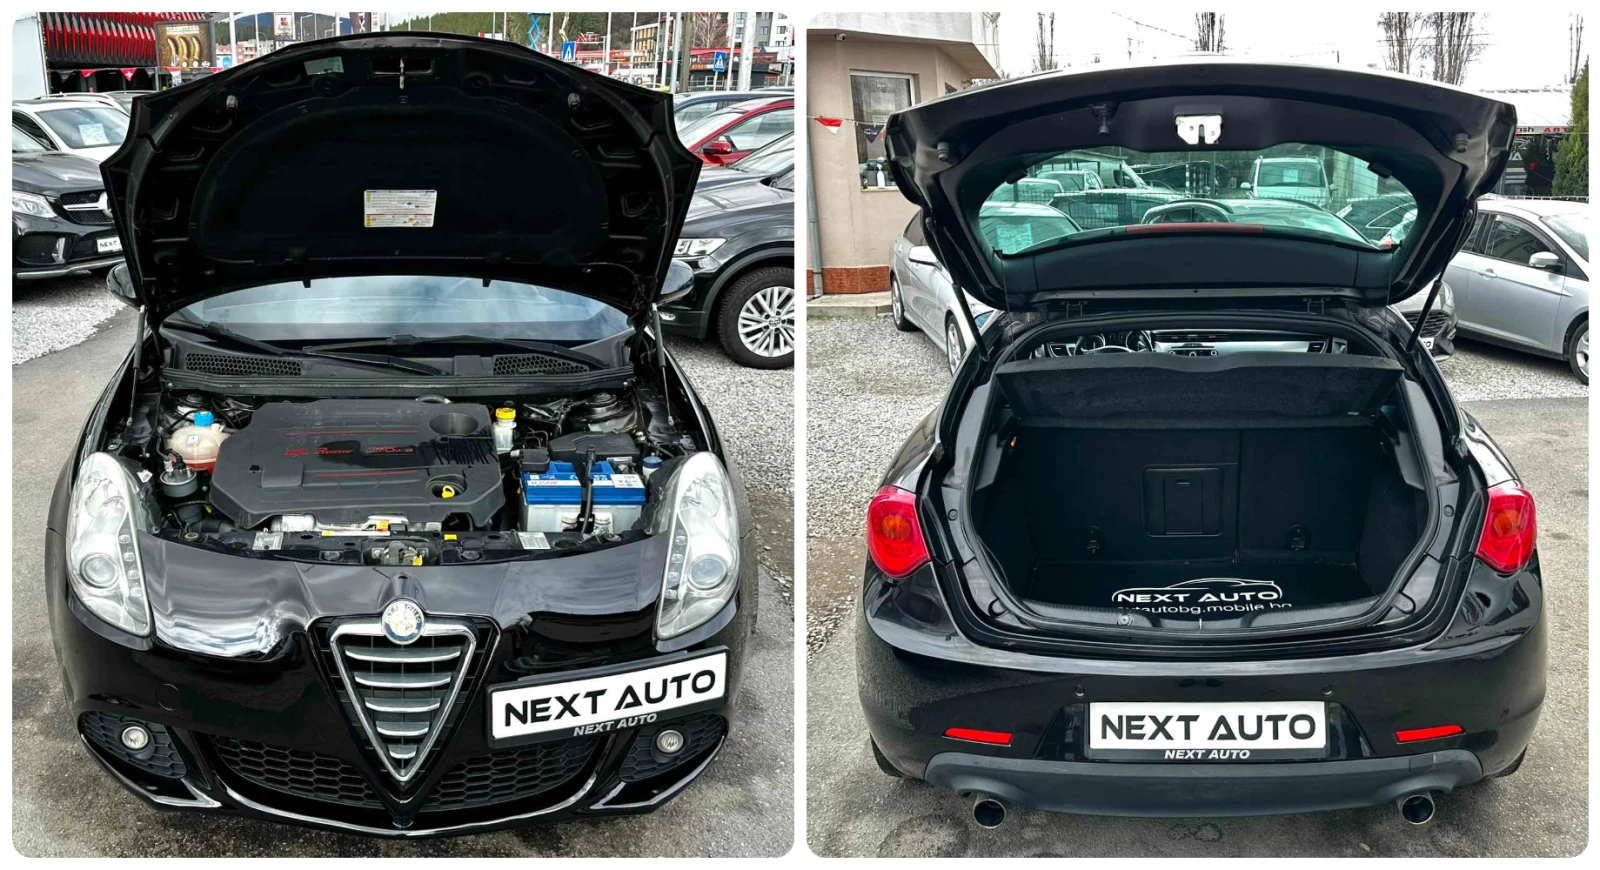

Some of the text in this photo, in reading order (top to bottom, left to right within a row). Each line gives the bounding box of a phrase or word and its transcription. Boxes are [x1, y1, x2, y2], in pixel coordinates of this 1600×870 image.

[100, 240, 117, 248] NEXT
[1117, 591, 1279, 603] NEXT AUTO
[504, 669, 716, 727] NEXT AUTO
[573, 713, 658, 737] NEXT AUTO
[1101, 713, 1316, 740] NEXT AUTO
[1164, 749, 1250, 759] NEXT AUTO
